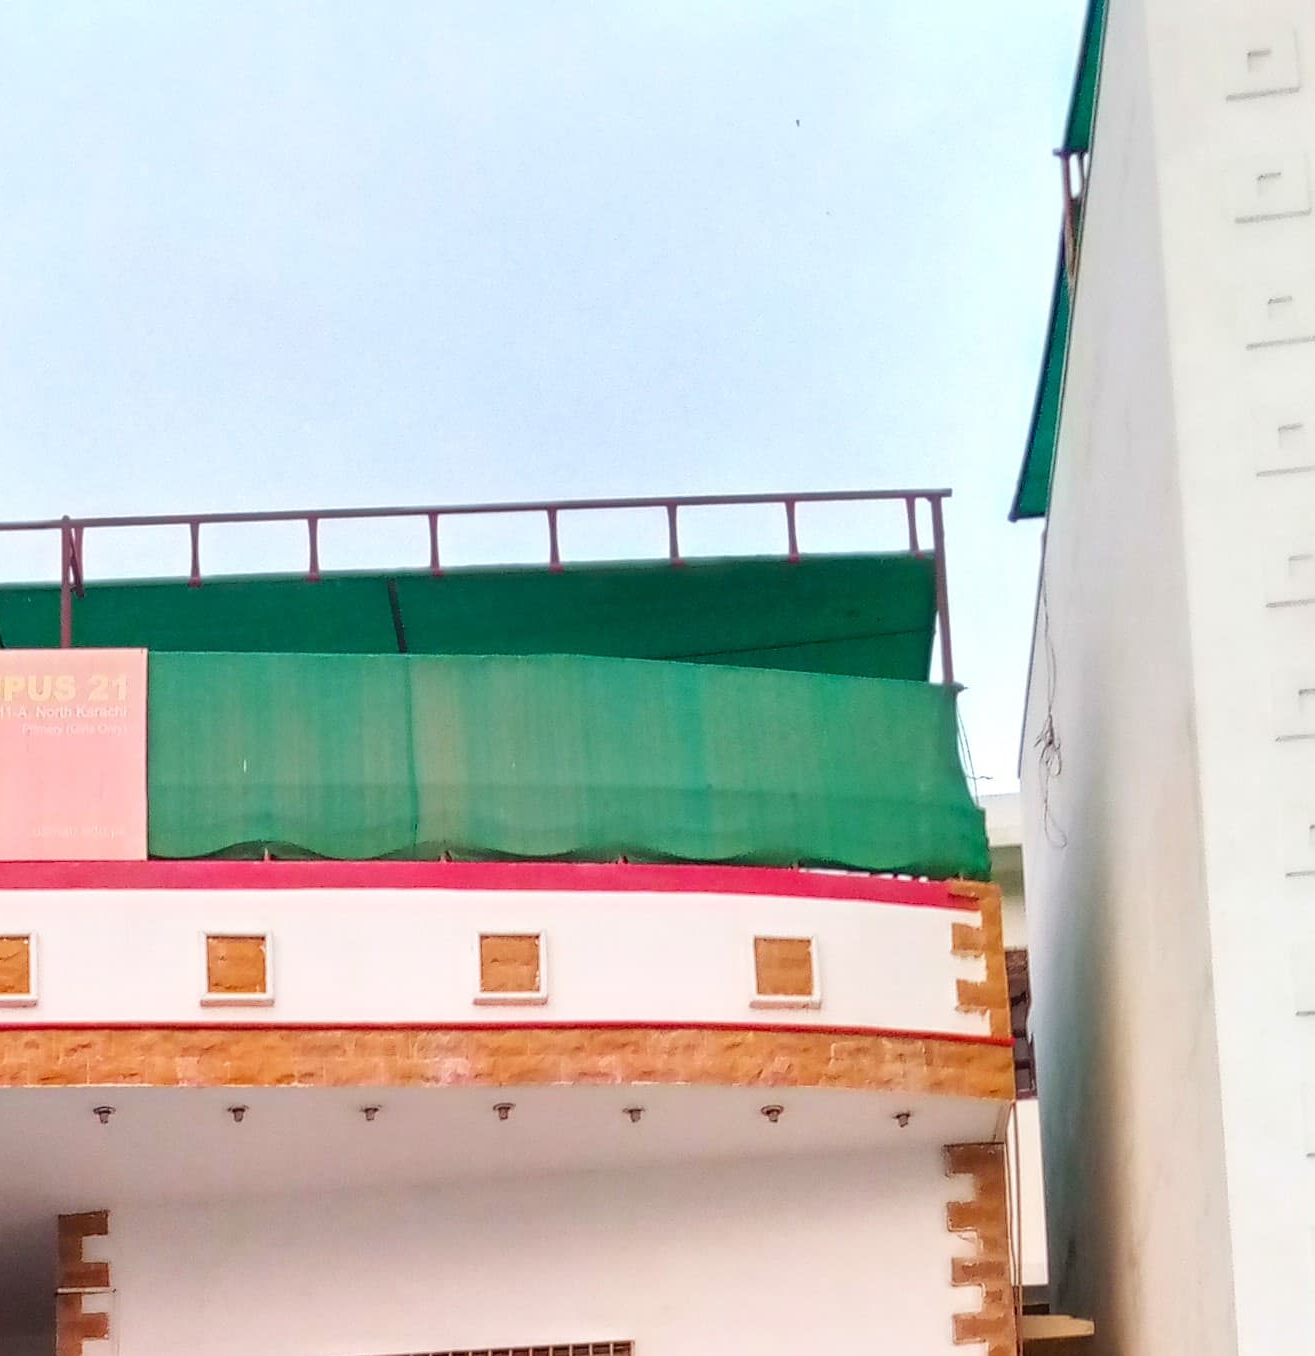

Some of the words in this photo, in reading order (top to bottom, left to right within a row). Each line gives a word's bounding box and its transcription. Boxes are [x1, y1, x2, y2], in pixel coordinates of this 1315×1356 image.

[88, 674, 128, 702] 21
[35, 705, 72, 719] North
[75, 704, 127, 719] Karachi
